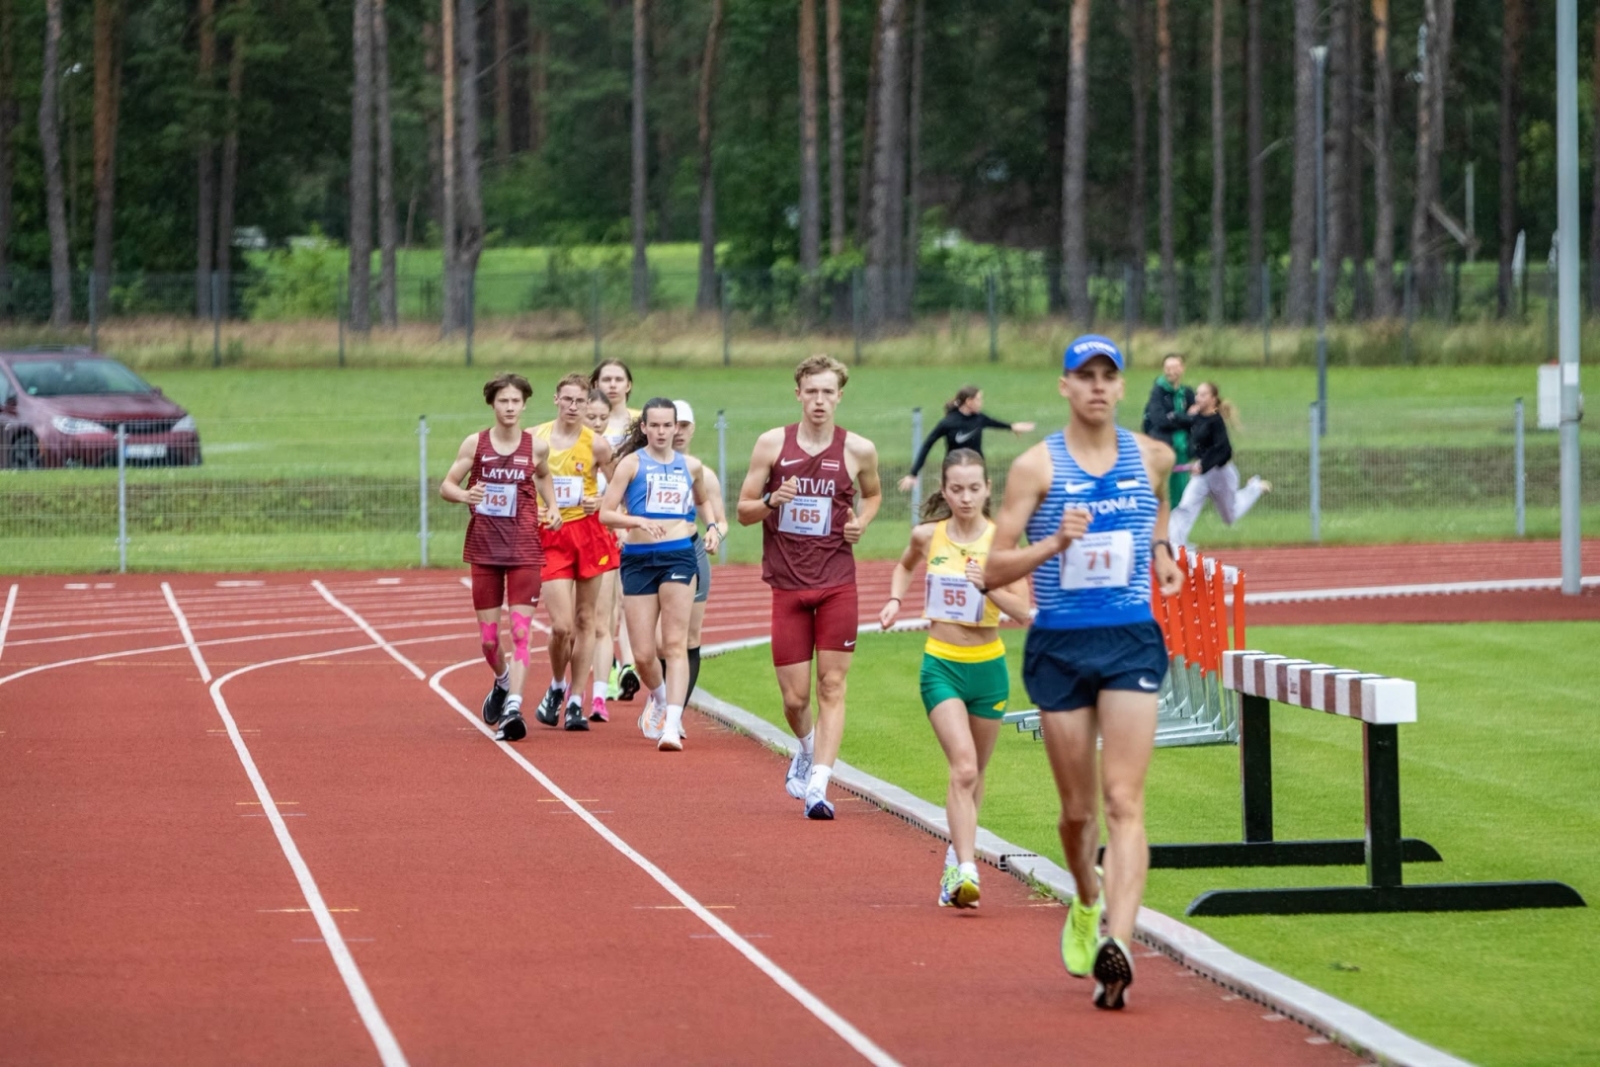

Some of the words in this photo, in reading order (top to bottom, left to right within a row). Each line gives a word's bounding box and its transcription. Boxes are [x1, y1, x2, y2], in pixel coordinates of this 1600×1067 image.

[482, 467, 525, 480] LATVIA
[555, 486, 570, 498] 11
[656, 491, 681, 504] 123
[485, 494, 507, 507] 143
[790, 508, 820, 524] 165
[1084, 550, 1112, 570] 71
[943, 589, 966, 607] 55
